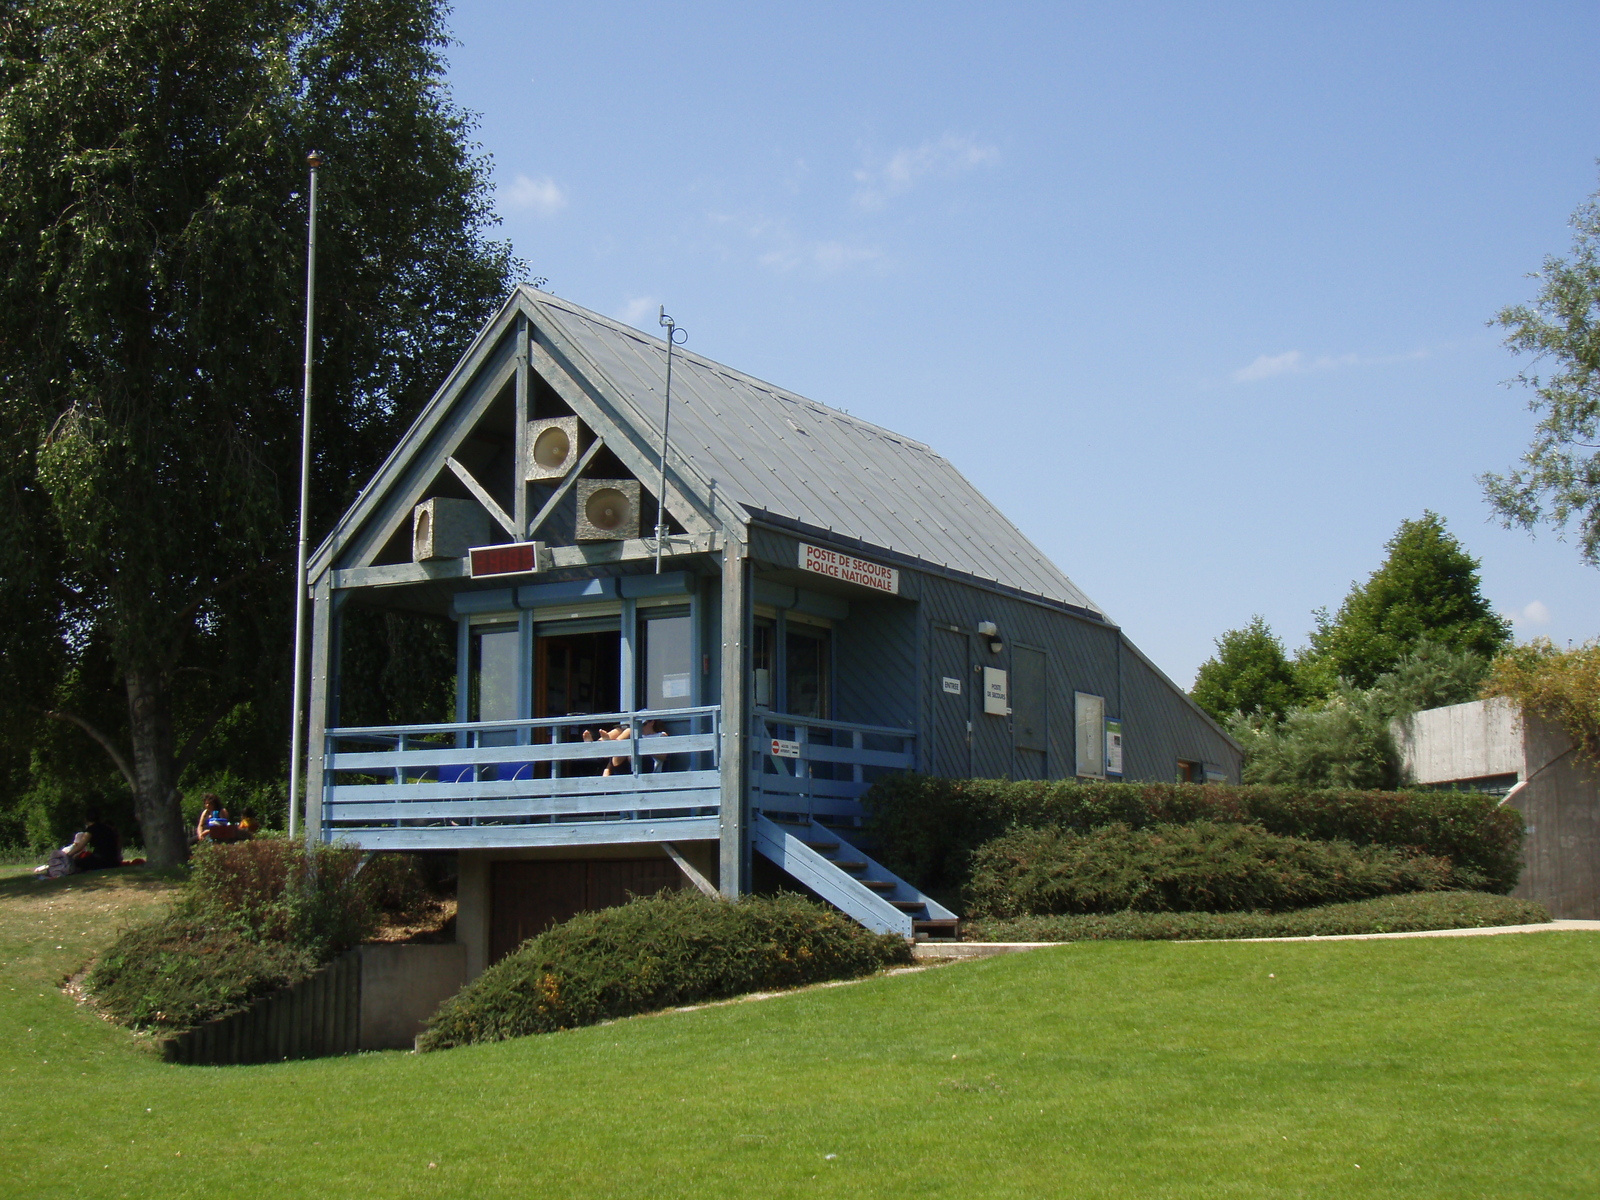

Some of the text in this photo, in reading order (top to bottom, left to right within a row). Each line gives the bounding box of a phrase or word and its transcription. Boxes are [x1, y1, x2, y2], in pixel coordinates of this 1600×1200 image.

[806, 559, 892, 591] POLICE NATIONALE
[807, 546, 892, 579] POSTE DE SECOURS
